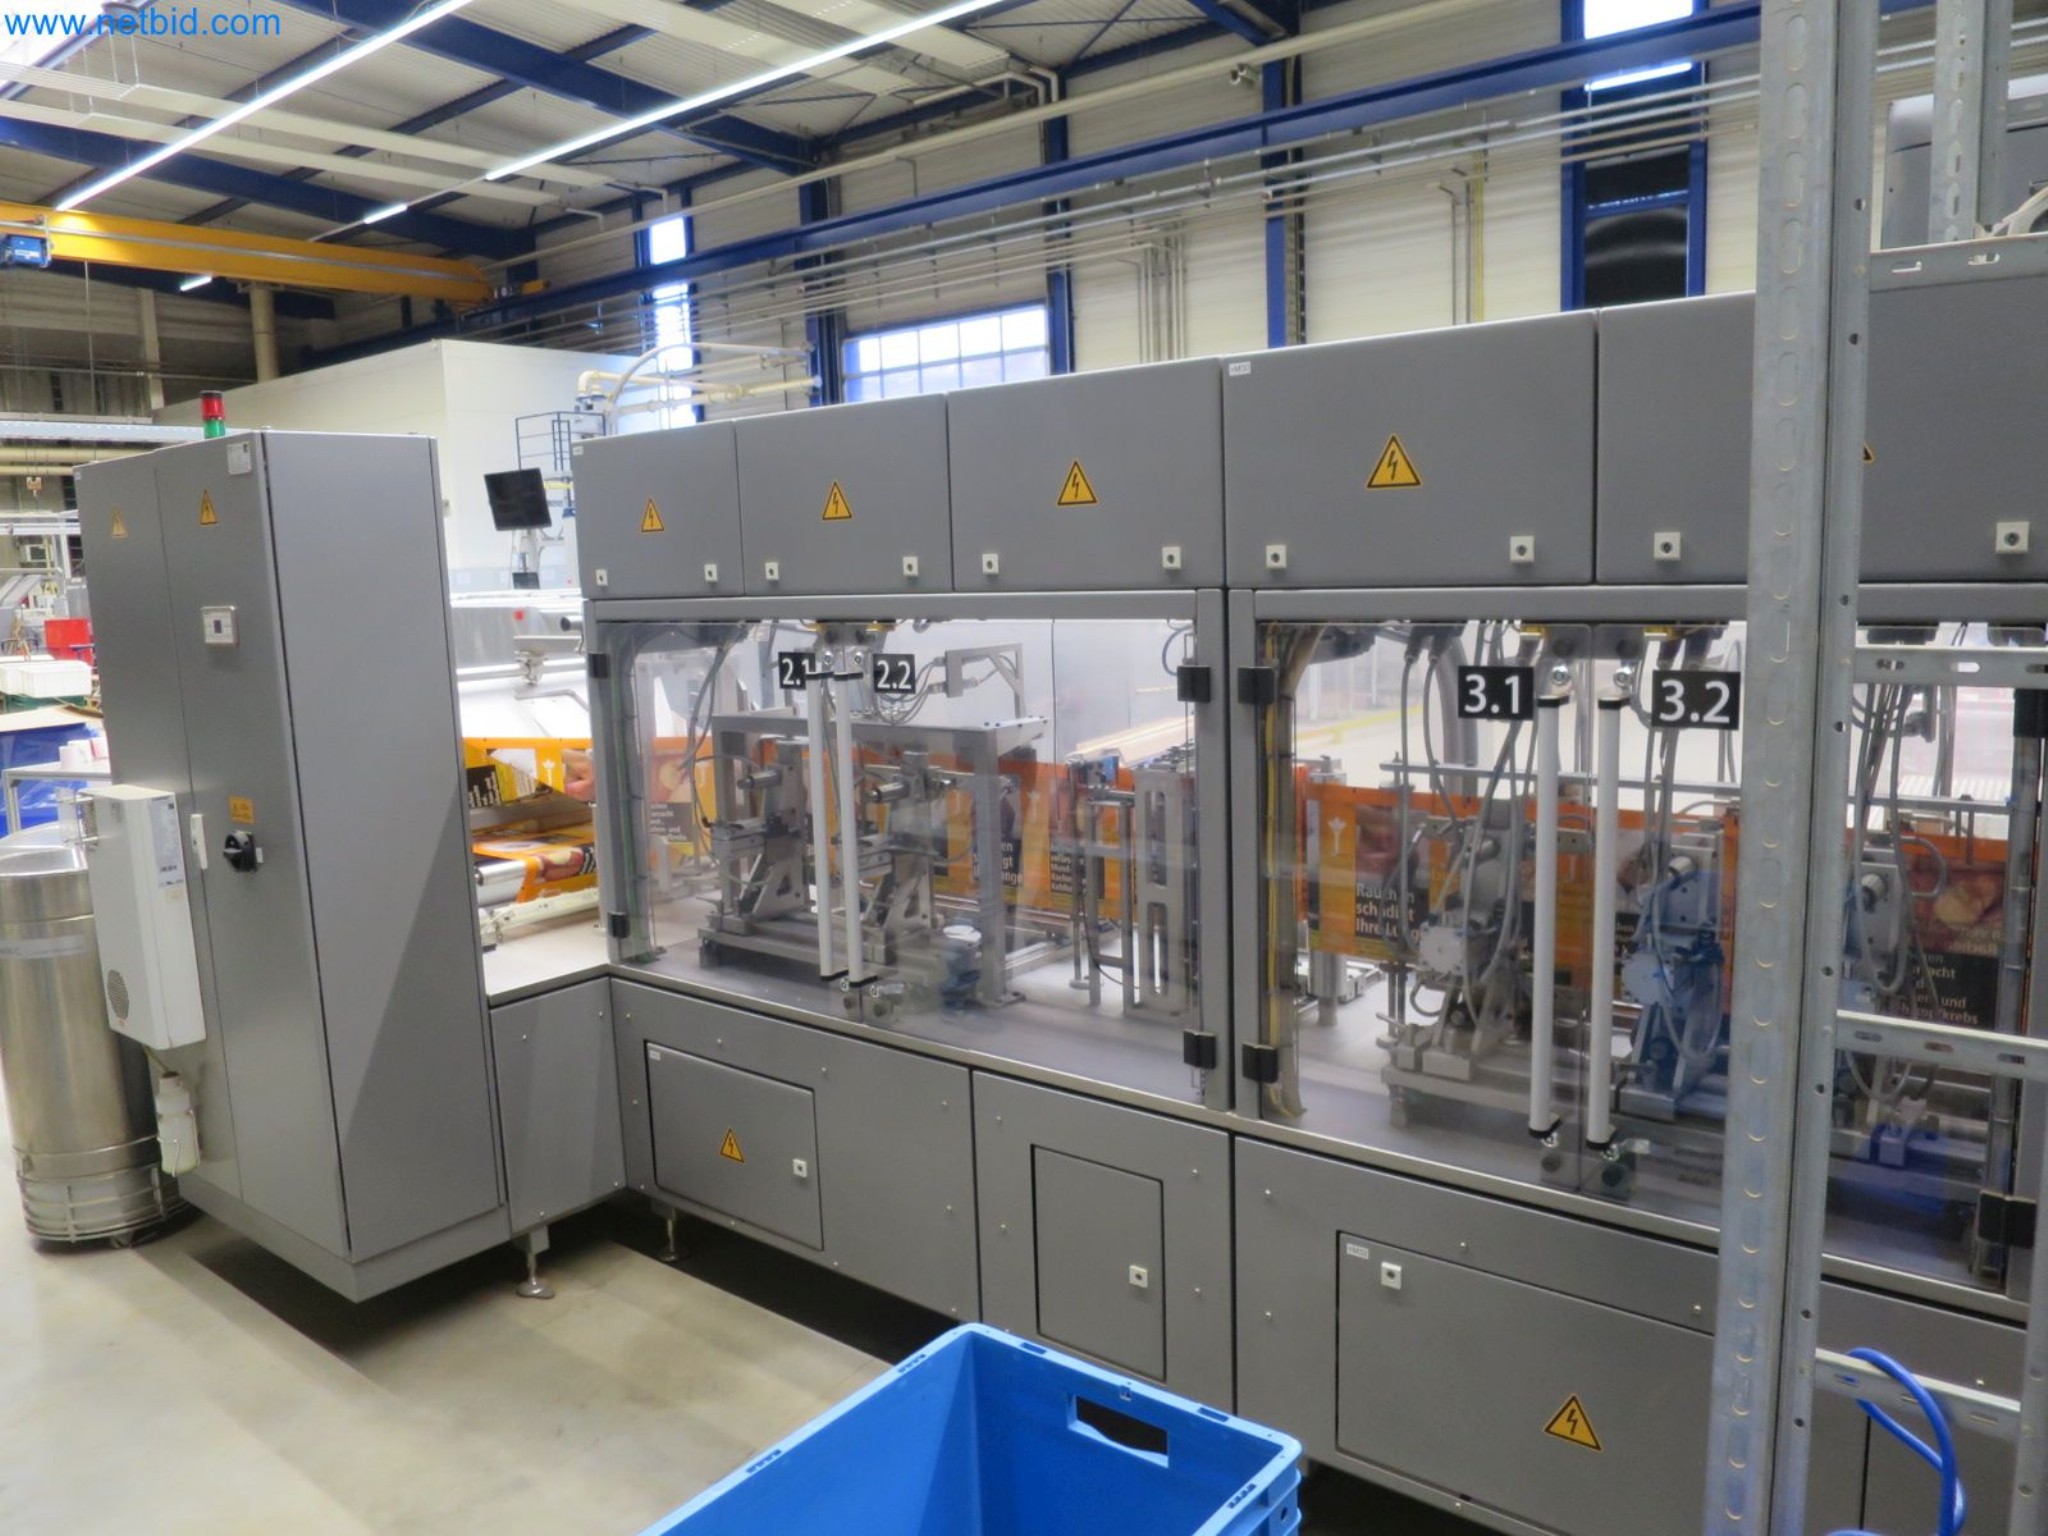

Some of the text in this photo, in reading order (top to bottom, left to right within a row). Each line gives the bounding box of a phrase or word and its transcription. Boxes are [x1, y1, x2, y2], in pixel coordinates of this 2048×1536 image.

[782, 658, 810, 686] 2.1
[877, 660, 912, 689] 2.2
[1464, 674, 1521, 714] 3.1
[1659, 679, 1731, 723] 3.2
